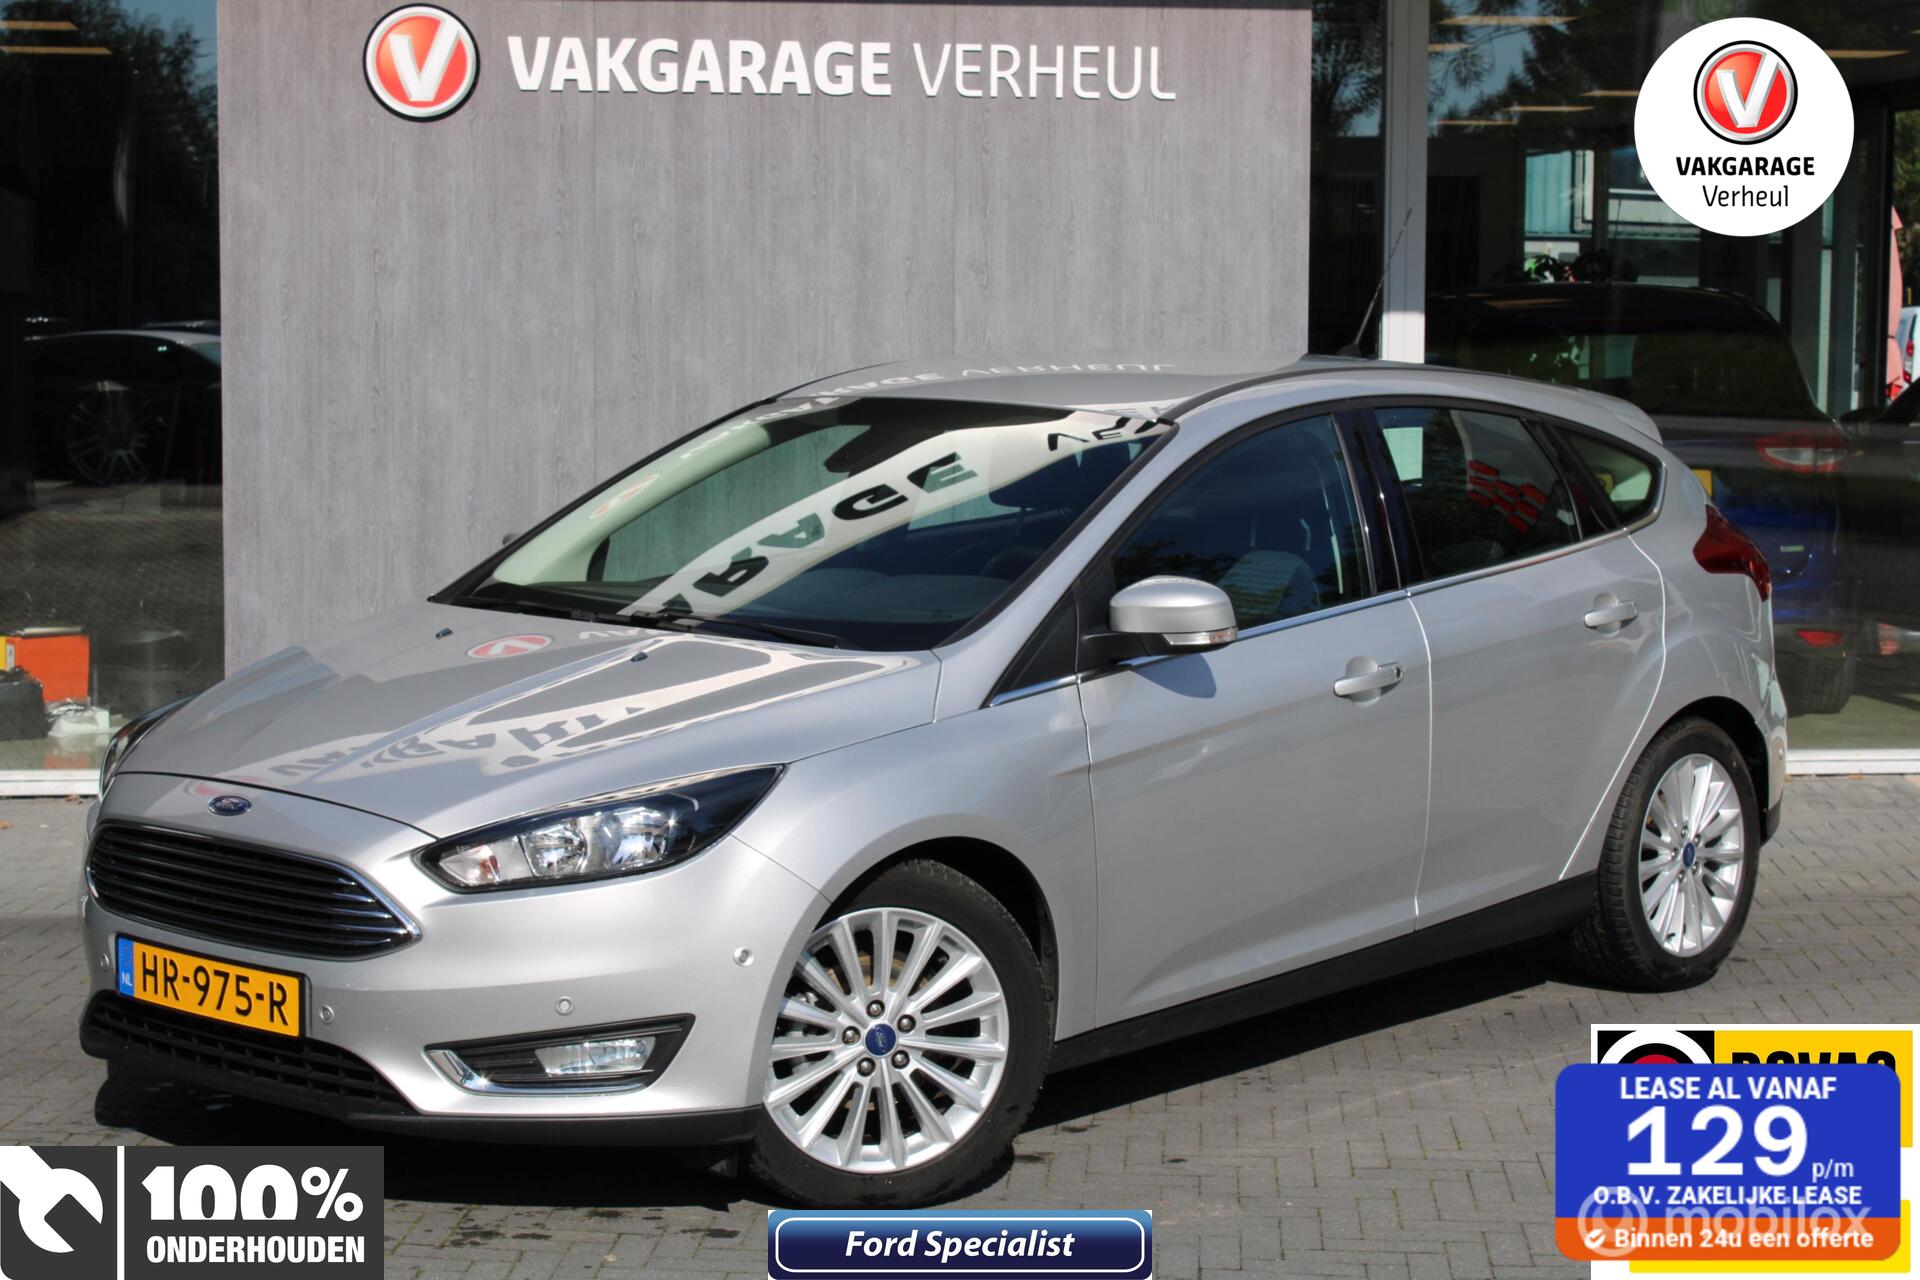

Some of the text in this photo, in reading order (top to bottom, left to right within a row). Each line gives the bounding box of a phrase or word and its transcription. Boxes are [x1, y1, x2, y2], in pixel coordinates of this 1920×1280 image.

[508, 36, 1177, 101] VAKGARAGE VERHEUL
[141, 951, 289, 1026] HR-975-R
